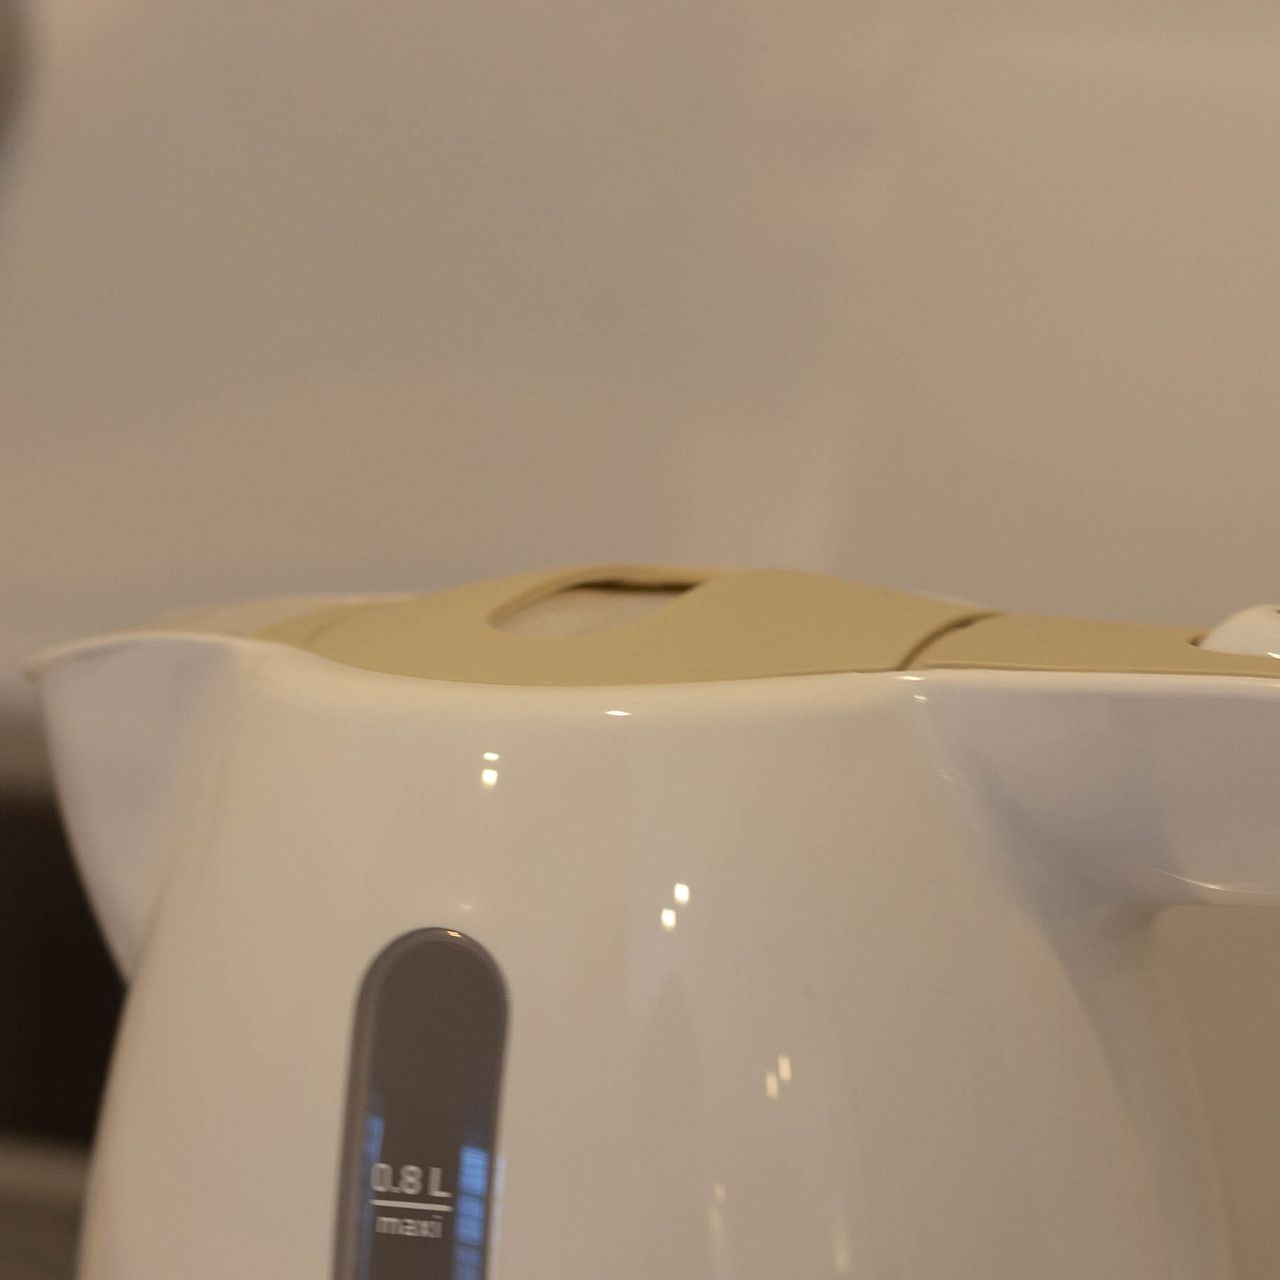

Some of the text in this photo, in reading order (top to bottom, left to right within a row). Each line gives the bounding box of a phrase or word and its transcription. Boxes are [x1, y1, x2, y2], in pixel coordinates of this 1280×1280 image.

[371, 1164, 452, 1198] 0.8 L
[376, 1213, 442, 1239] maxi
